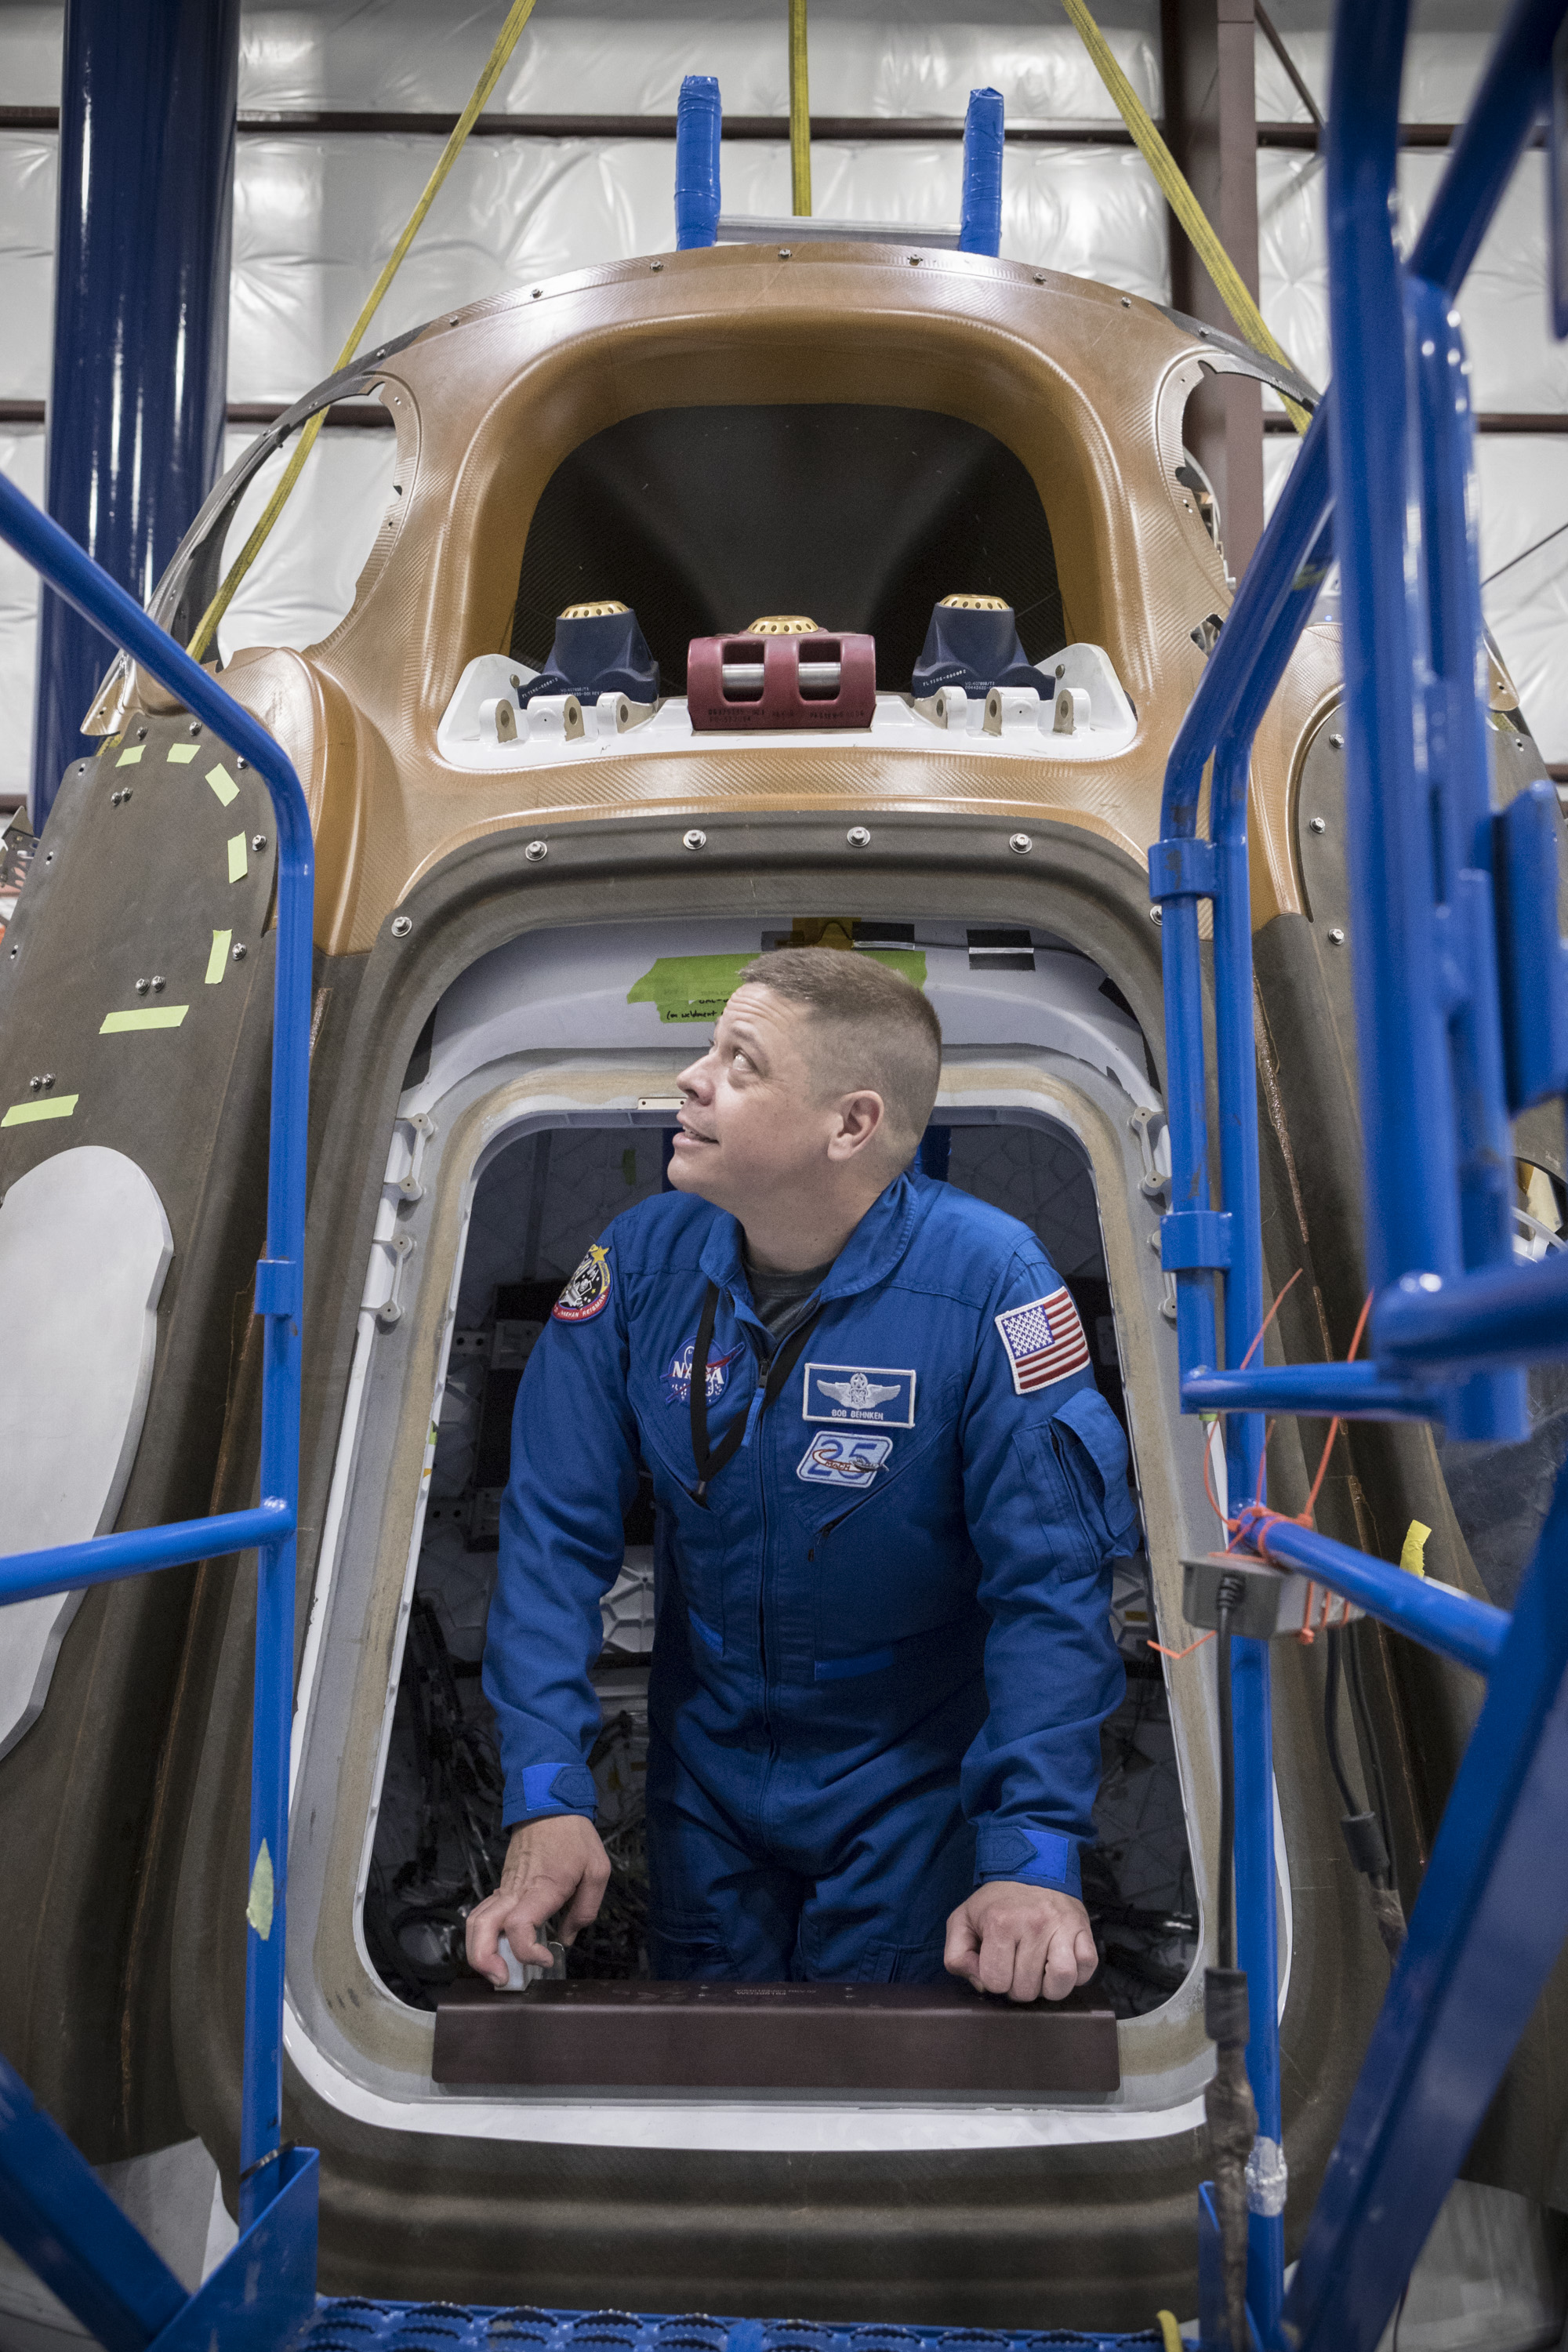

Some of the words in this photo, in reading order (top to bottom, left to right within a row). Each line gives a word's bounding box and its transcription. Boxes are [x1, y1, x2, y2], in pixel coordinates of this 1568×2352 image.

[582, 1294, 606, 1316] REISMAN
[831, 1409, 847, 1417] BOB
[851, 1410, 884, 1421] BEHNKEN
[808, 1439, 877, 1480] 25
[825, 1461, 851, 1471] MACH
